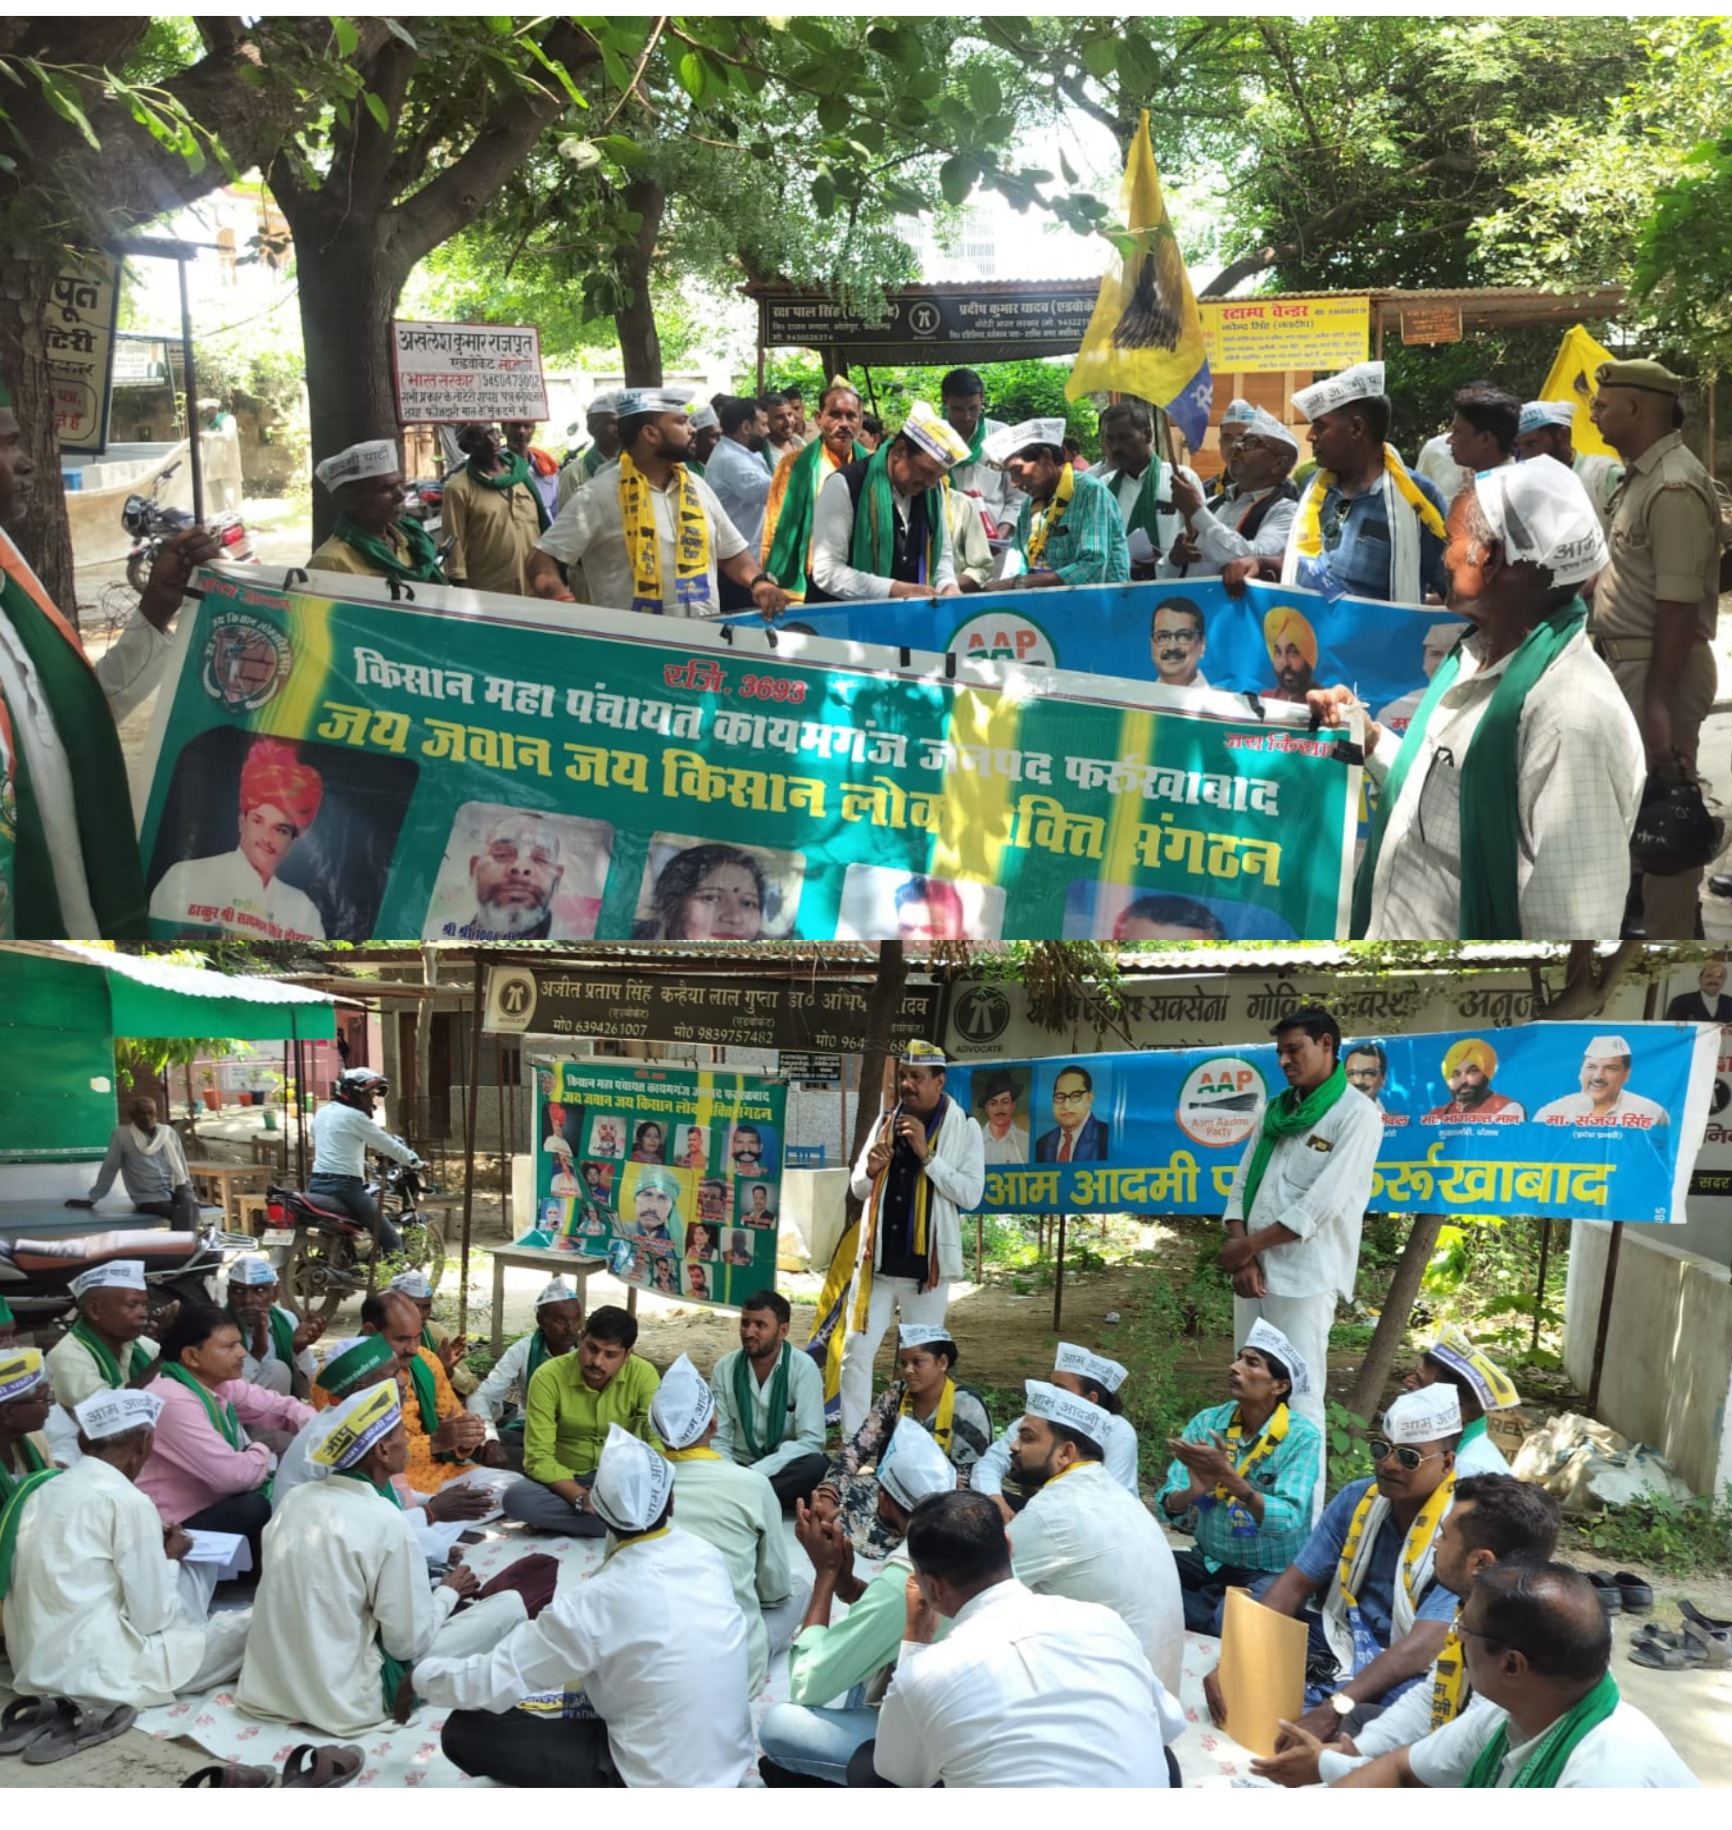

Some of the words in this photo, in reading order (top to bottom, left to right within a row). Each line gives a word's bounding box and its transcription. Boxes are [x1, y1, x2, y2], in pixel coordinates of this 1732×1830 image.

[959, 302, 987, 316] प्रदीप
[989, 302, 1019, 318] कुमार
[1021, 302, 1049, 315] यादव
[1051, 299, 1096, 317] (एडवोके
[1222, 306, 1265, 320] स्टाम्प
[453, 333, 487, 355] कुमार
[489, 334, 534, 356] राजपूत
[353, 646, 474, 705] किसान
[484, 677, 555, 718] महा
[565, 682, 703, 741] पंचायत
[713, 709, 908, 769] कायमगंज
[317, 699, 409, 754] जय
[420, 716, 553, 777] जवान
[564, 743, 649, 792] जय
[661, 747, 827, 828] किसान
[540, 975, 583, 999] अजीत
[585, 981, 623, 1001] प्रताप
[626, 978, 654, 1004] सिंह
[661, 979, 705, 1007] कन्हैया
[709, 988, 743, 1008] लाल
[745, 990, 781, 1015] गुप्ता
[1148, 984, 1232, 1023] सक्सेना
[575, 1019, 649, 1036] 6394261007
[697, 1029, 774, 1046] 9839757482
[955, 1045, 1004, 1054] ADVOCATE
[1196, 1069, 1254, 1095] AAP
[563, 1091, 582, 1105] जय
[583, 1092, 613, 1107] जवान
[614, 1095, 635, 1110] जय
[636, 1096, 673, 1113] किसान
[1190, 1117, 1216, 1129] Aam
[1217, 1116, 1250, 1129] Aadmi
[1546, 1113, 1570, 1127] मा.
[1575, 1111, 1618, 1128] संजय
[1620, 1112, 1654, 1130] सिंह
[1205, 1126, 1233, 1139] Party
[983, 1170, 1062, 1206] आम
[1070, 1150, 1202, 1205] आदमी
[1699, 1175, 1732, 1189] सदर
[1061, 1352, 1084, 1364] आम
[87, 1403, 120, 1424] आम
[1031, 1393, 1055, 1409] आम
[1059, 1401, 1100, 1426] आदमी
[677, 1417, 699, 1443] आम
[1401, 1415, 1433, 1432] आम
